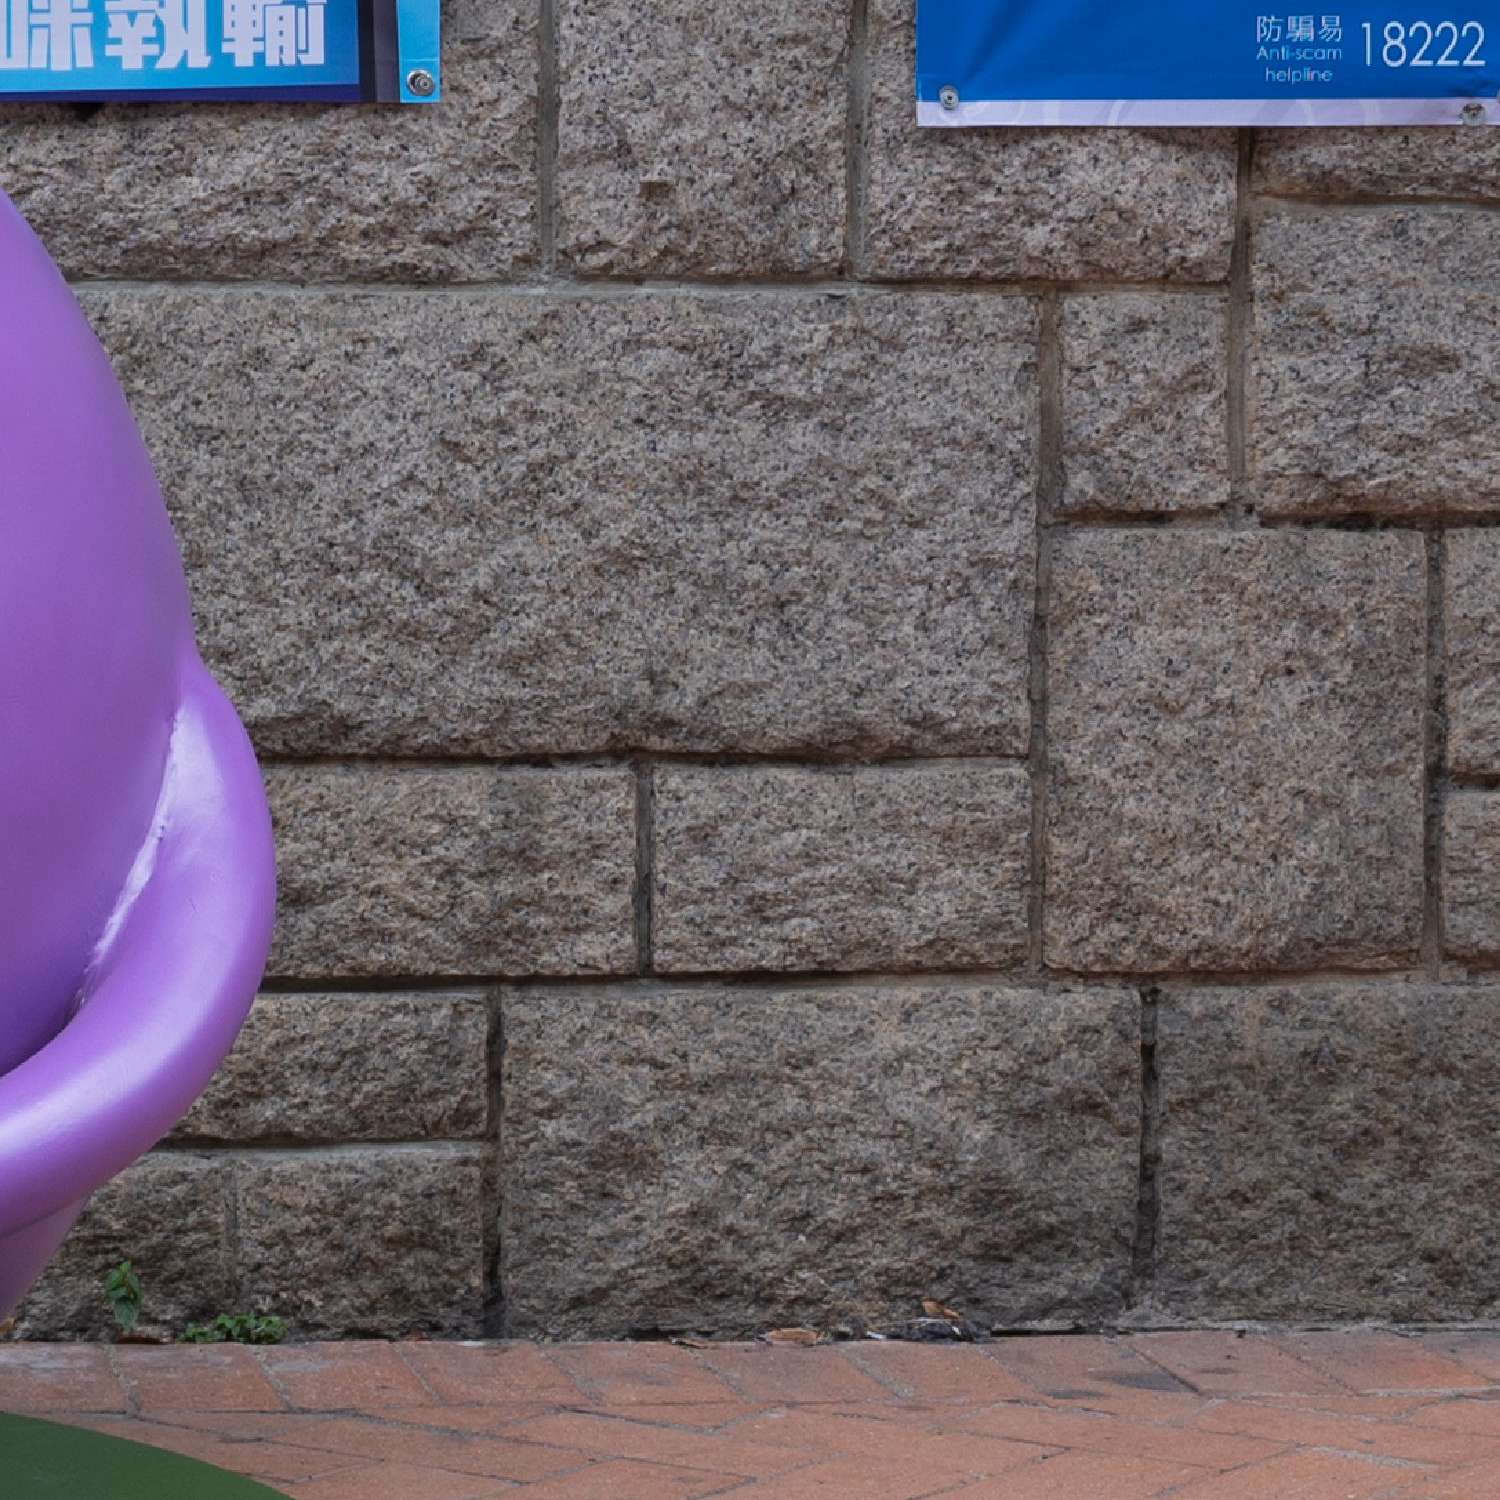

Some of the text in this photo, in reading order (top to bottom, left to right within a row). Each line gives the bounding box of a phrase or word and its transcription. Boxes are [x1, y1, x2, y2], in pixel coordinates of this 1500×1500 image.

[1256, 15, 1342, 43] 防騙易
[1255, 45, 1343, 60] Anti-scam
[1361, 21, 1486, 67] 18222
[1265, 67, 1333, 85] helpline
